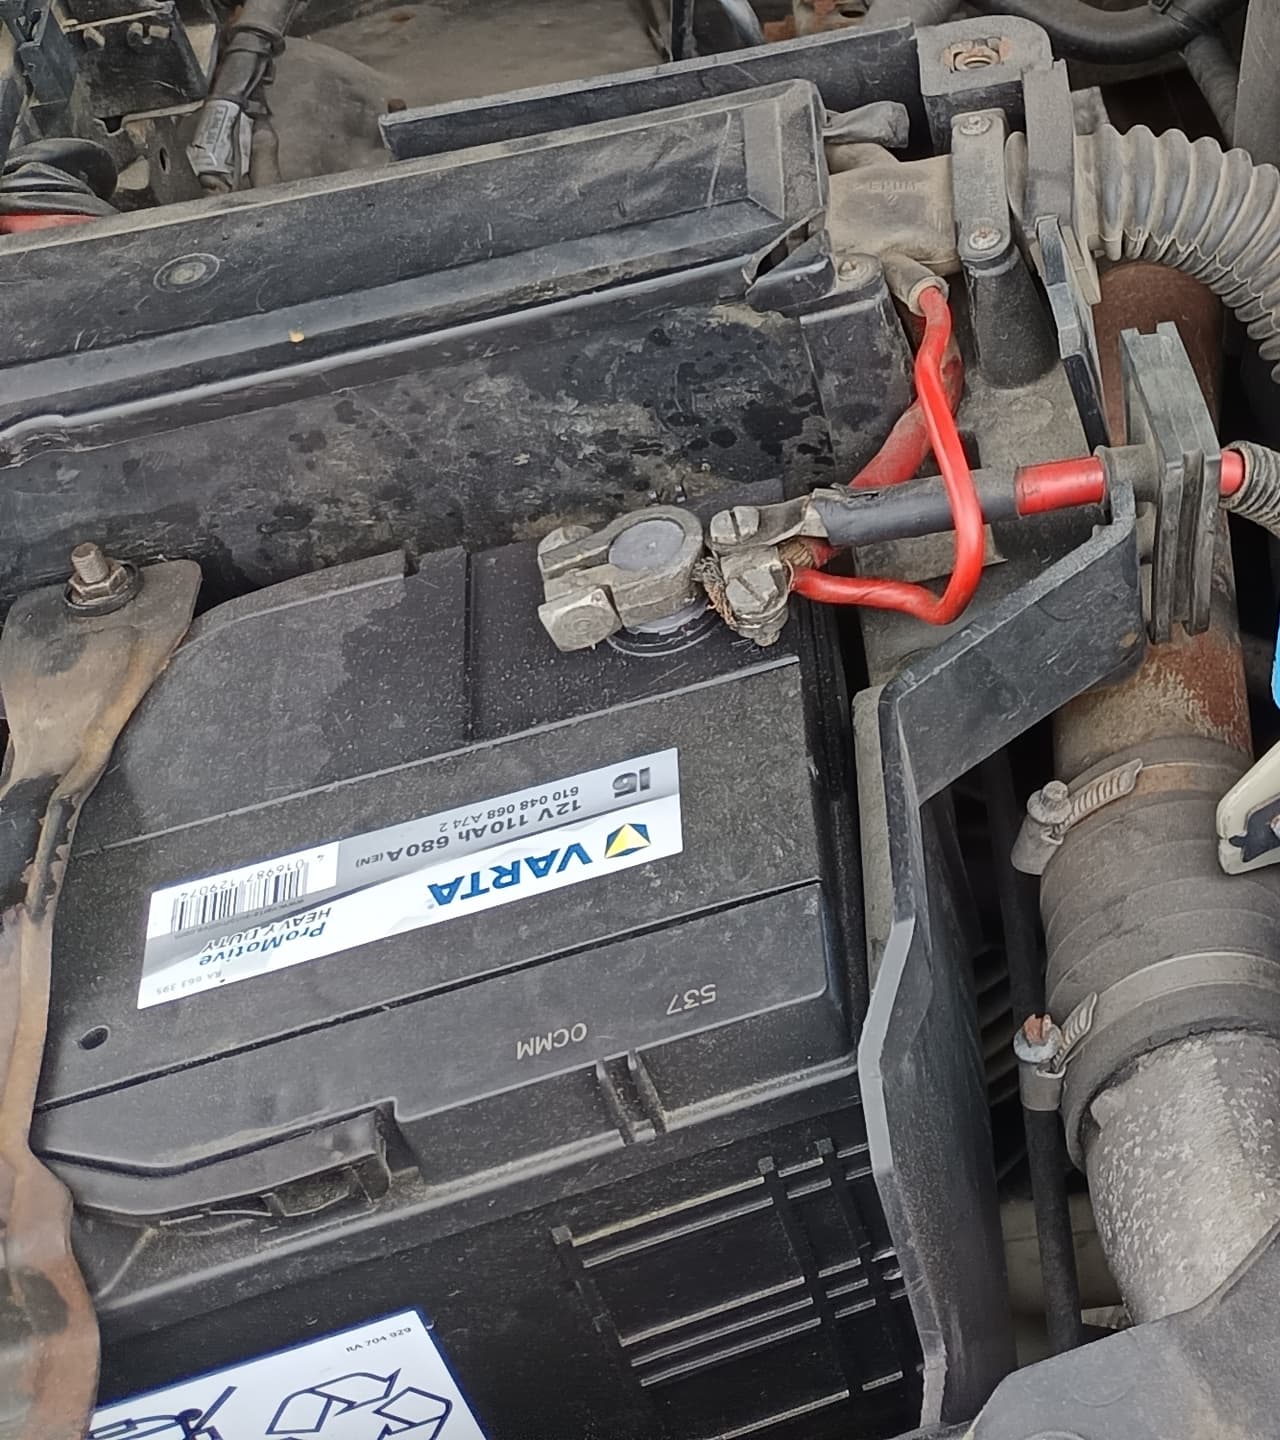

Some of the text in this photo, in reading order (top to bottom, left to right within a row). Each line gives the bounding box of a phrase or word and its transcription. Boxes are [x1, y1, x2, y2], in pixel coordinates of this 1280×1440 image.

[519, 794, 549, 810] 048
[553, 786, 580, 801] 610
[487, 803, 516, 818] 068
[537, 800, 582, 823] 12V
[427, 842, 594, 906] VARTA
[202, 907, 332, 953] HEAVY DUTY
[199, 922, 327, 967] ProMotive
[665, 984, 717, 1015] 537
